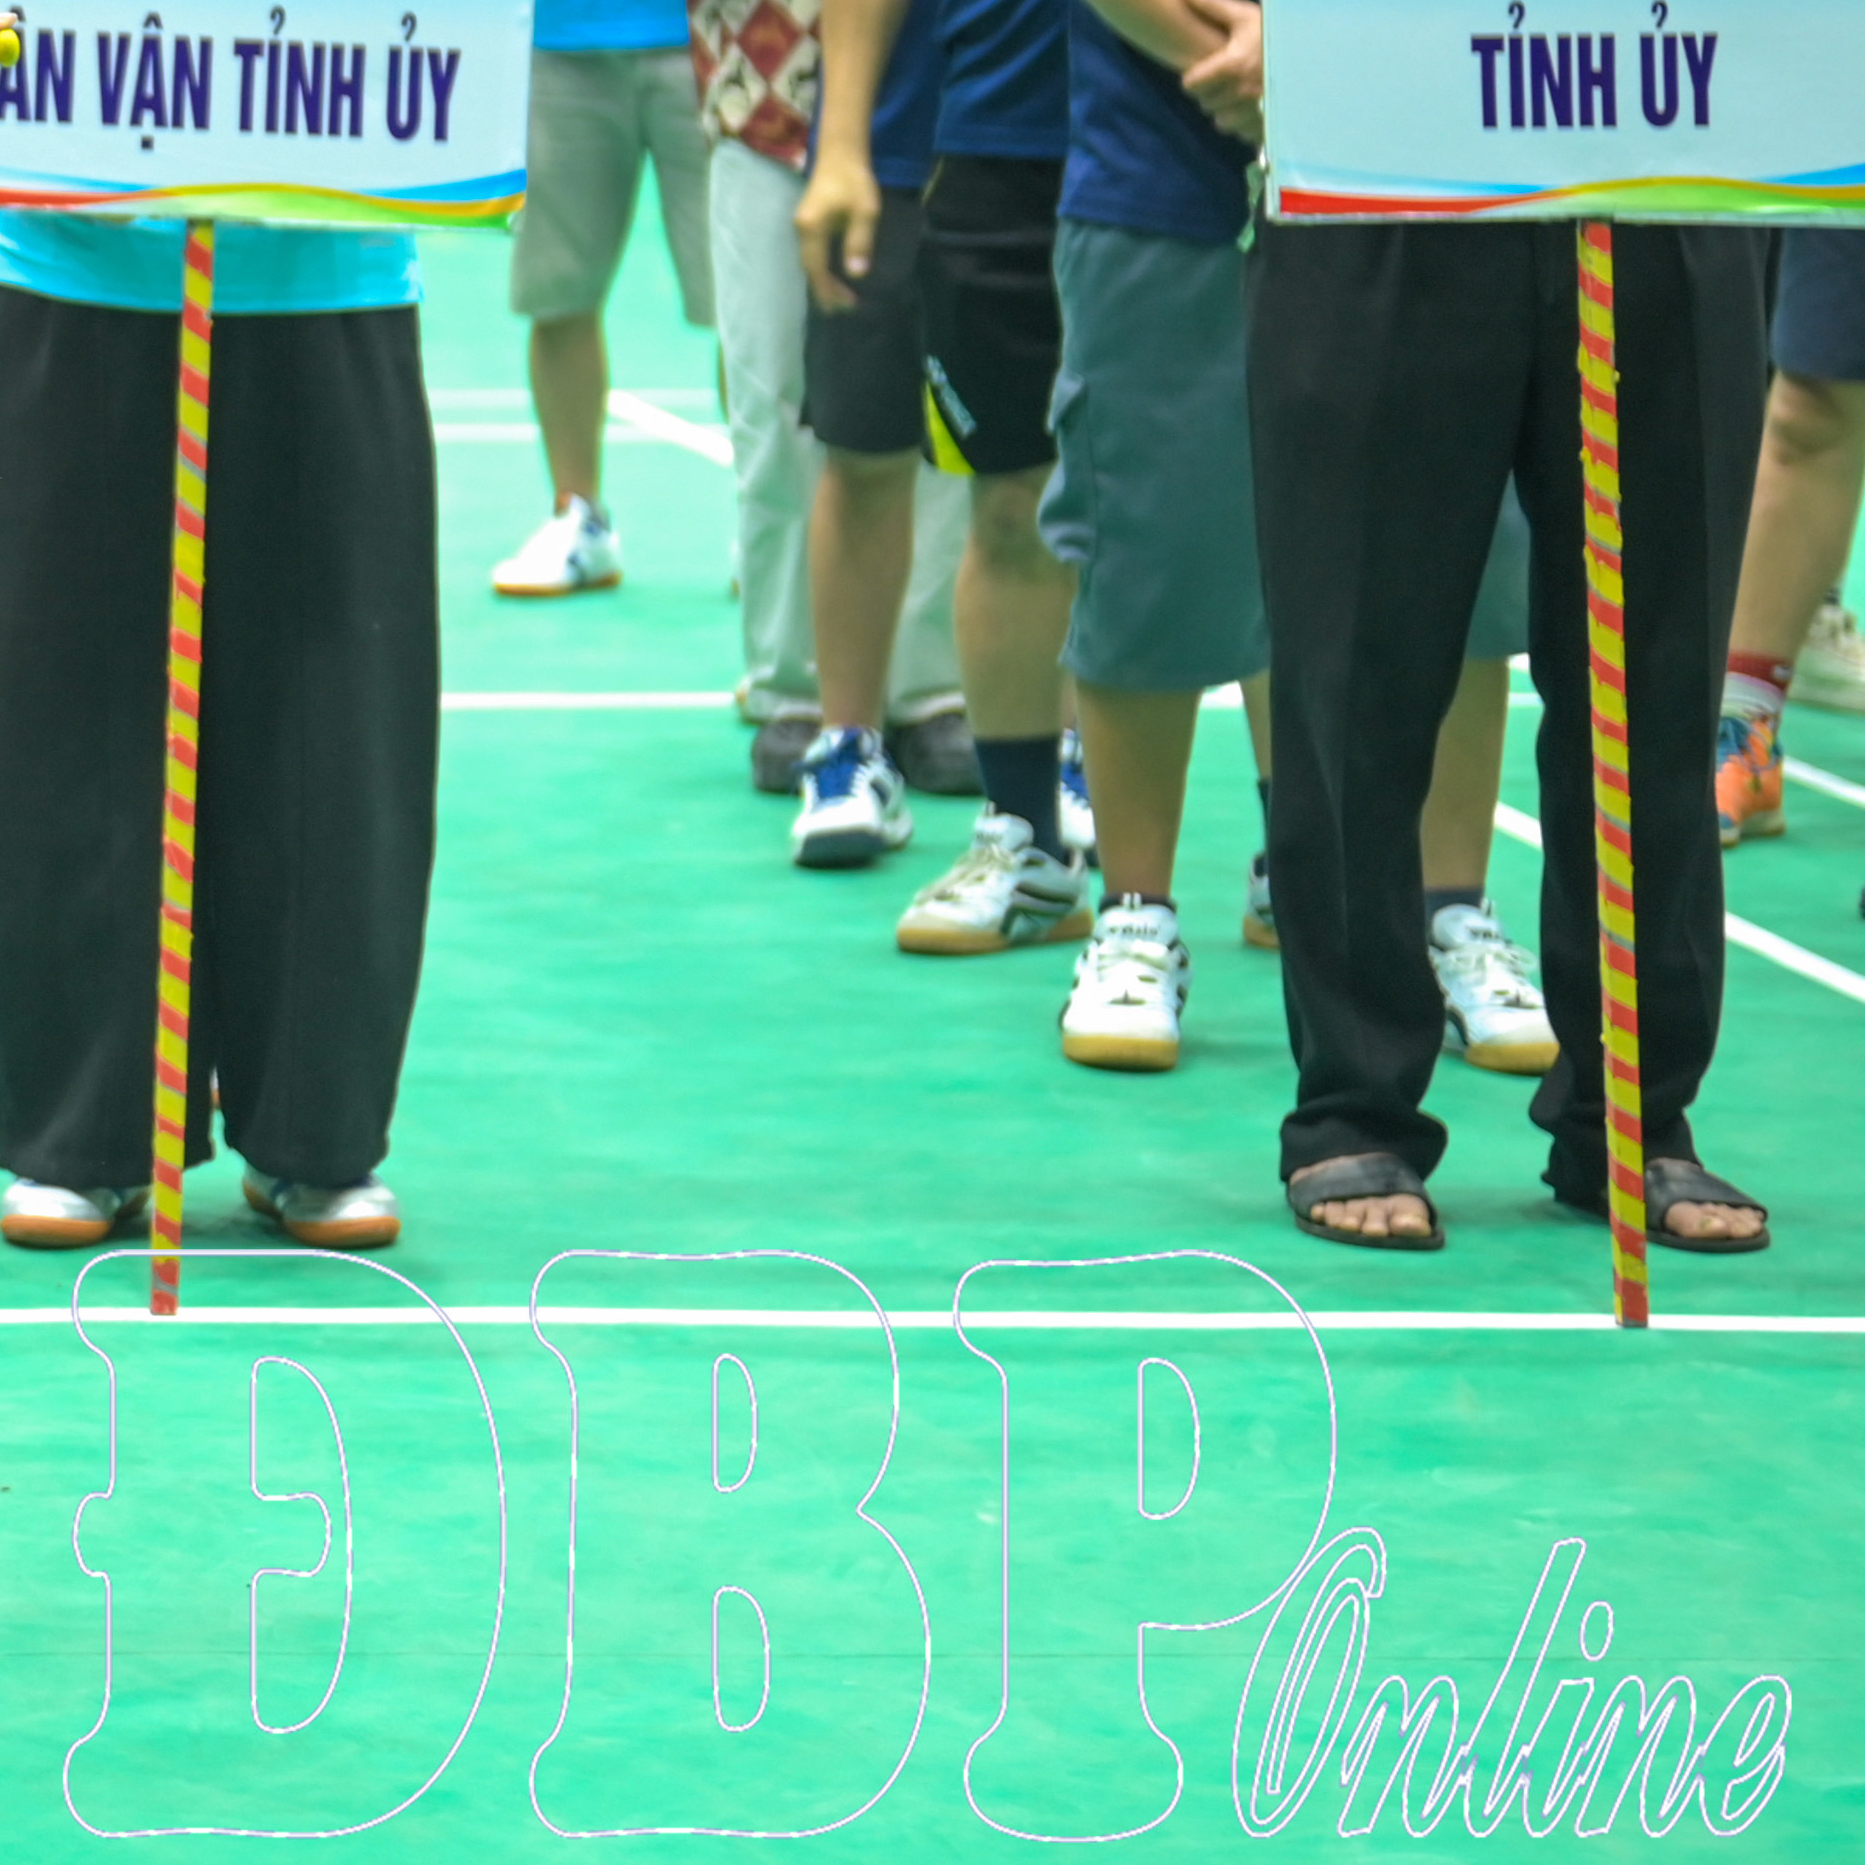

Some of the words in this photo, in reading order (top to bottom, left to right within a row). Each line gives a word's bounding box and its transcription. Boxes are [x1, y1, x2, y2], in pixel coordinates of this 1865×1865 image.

[96, 12, 212, 150] VẬN
[234, 6, 365, 138] TỈNH
[386, 12, 461, 143] ỦY
[1470, 0, 1617, 128] TỈNH
